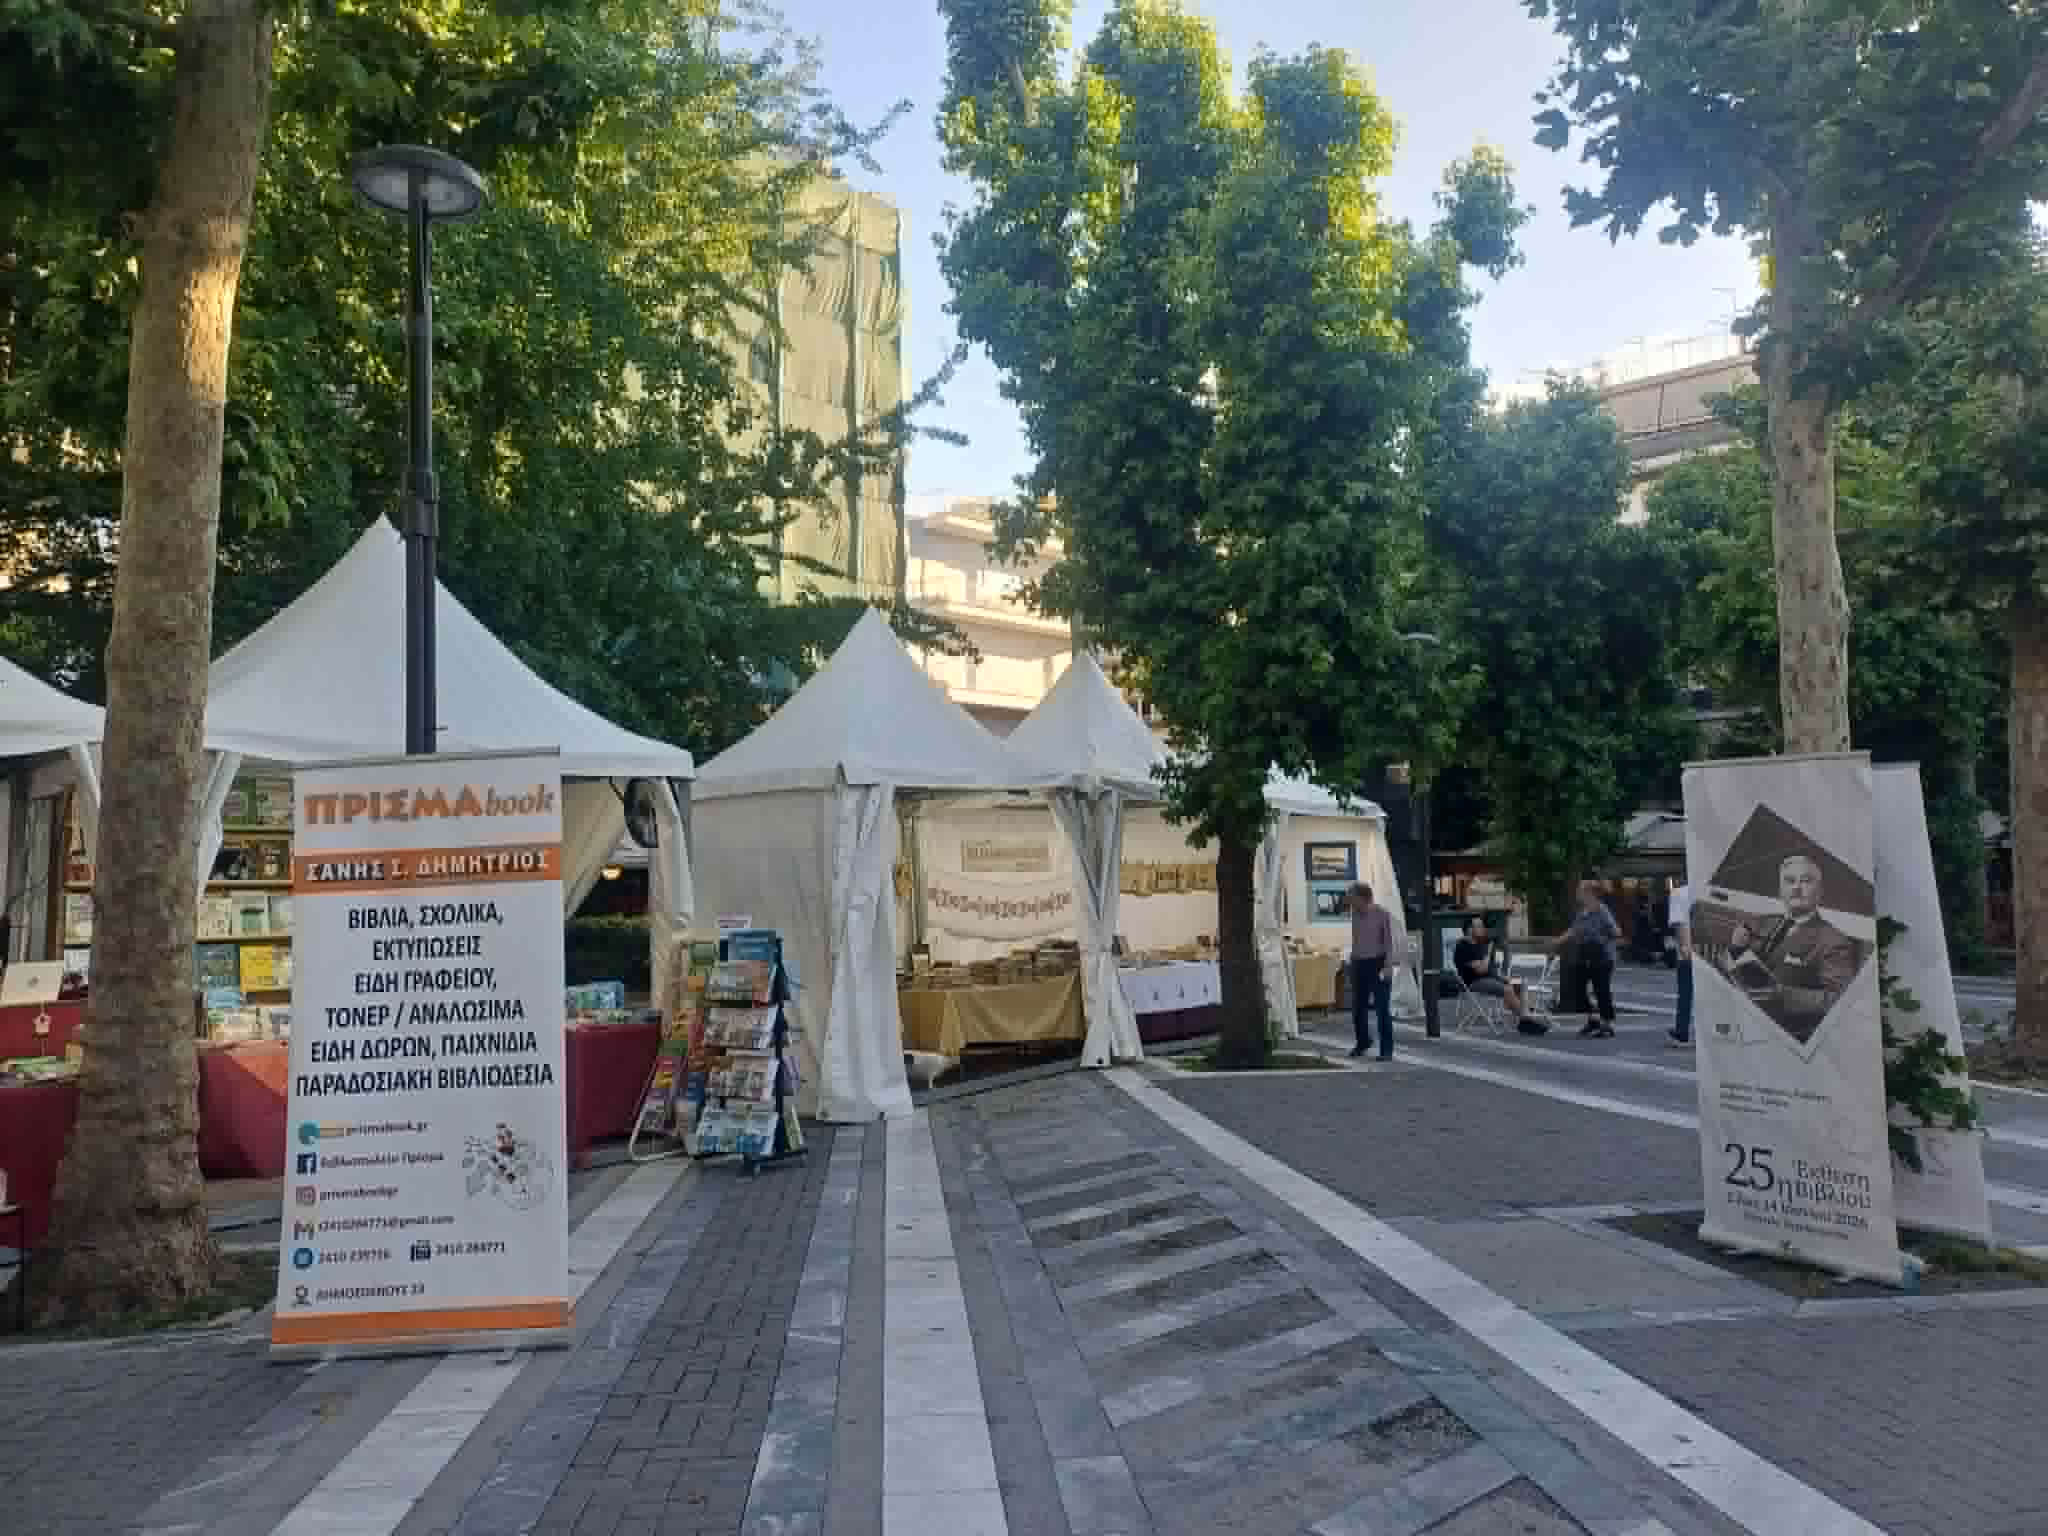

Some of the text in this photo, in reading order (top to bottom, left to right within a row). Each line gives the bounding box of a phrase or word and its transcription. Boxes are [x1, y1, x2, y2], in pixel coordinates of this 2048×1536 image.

[348, 902, 504, 931] ΒΙΒΛΙΑ, ΣΧΟΛΙΚΑ,
[373, 936, 481, 961] ΕΚΤΥΠΩΣΕΙΣ
[355, 967, 497, 994] ΕΙΔΗ ΓΡΑΦΕΙΟΥ,
[326, 1005, 390, 1028] ΤΟΝΕΡ
[408, 1000, 525, 1025] ΑΝΑΛΩΣΙΜΑ
[311, 1032, 537, 1063] ΕΙΔΗ ΔΩΡΩΝ, ΠΑΙΧΝΙΔΙΑ
[296, 1064, 554, 1096] ΠΑΡΑΔΟΣΙΑΚΗ ΒΙΒΛΙΟΔΕΣΙΑ
